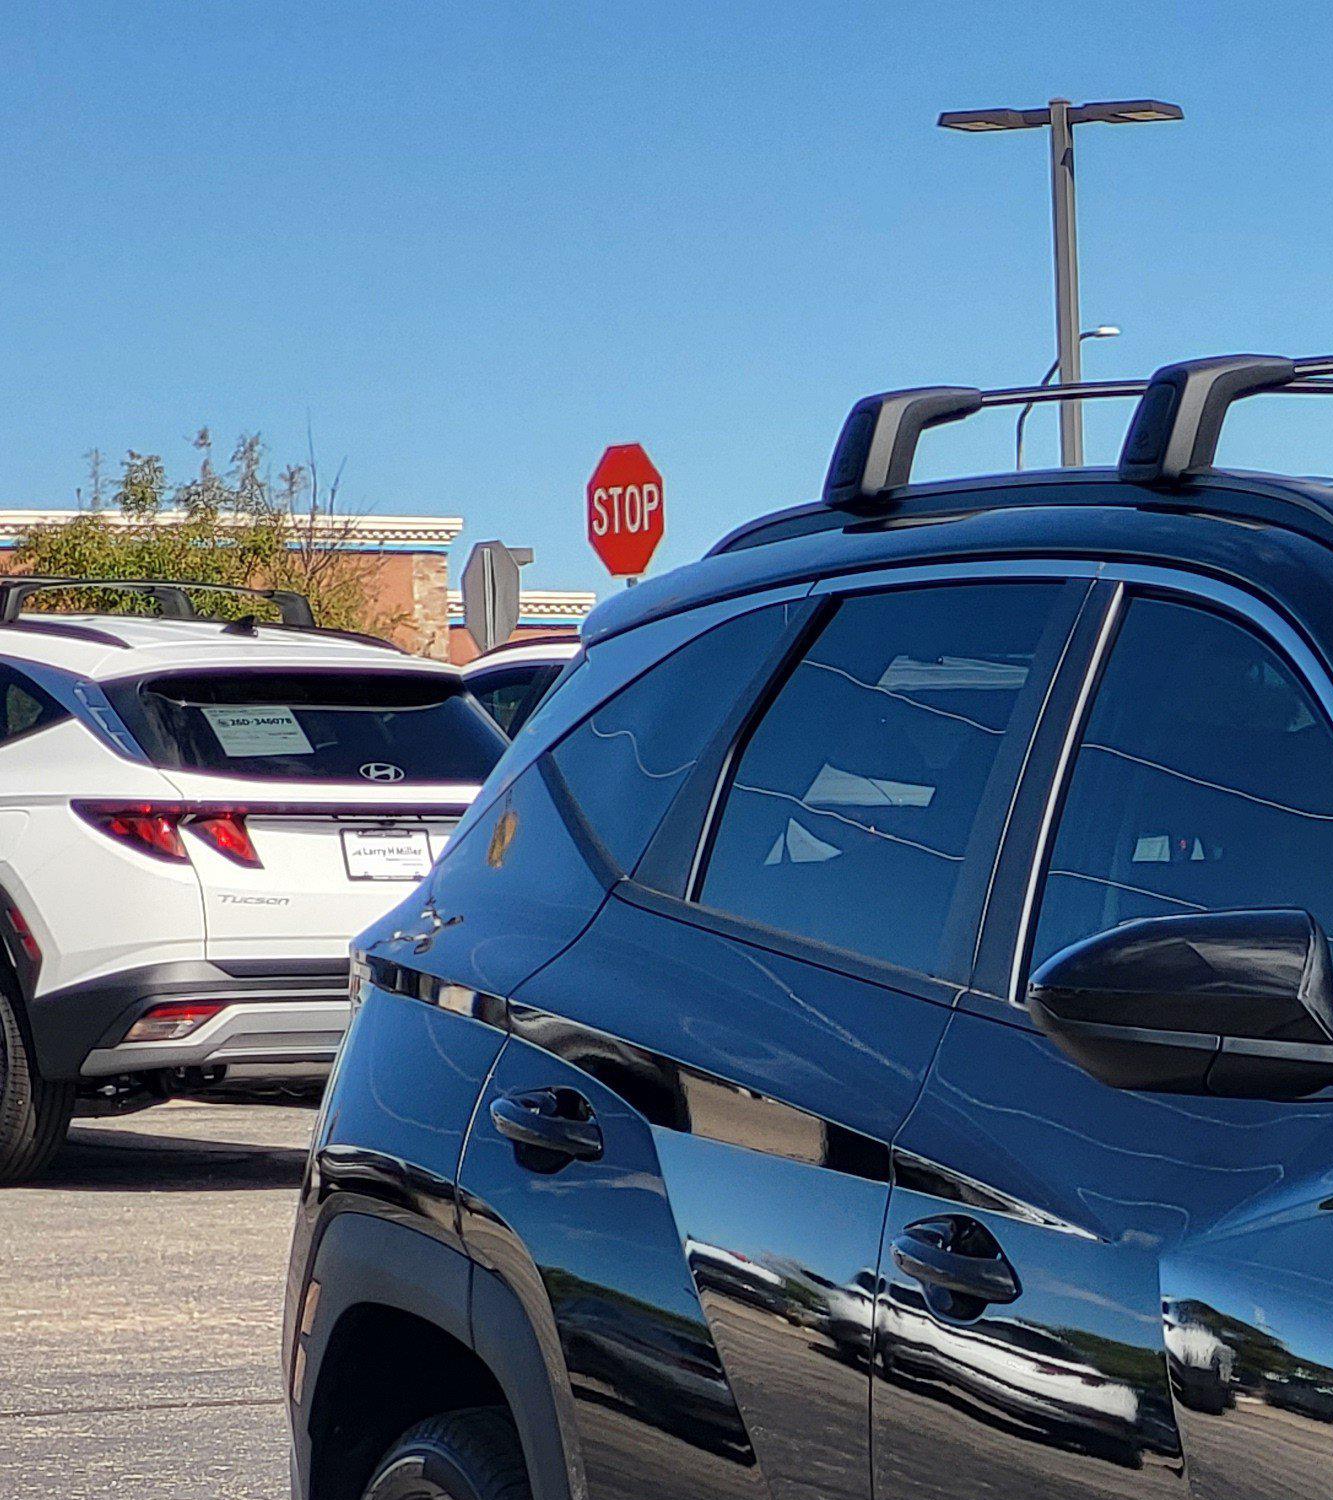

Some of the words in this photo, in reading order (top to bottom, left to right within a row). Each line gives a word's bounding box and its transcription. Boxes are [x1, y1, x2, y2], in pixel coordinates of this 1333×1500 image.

[592, 483, 659, 536] STOP
[363, 847, 386, 857] Larry
[396, 846, 422, 856] Miller
[217, 894, 290, 906] Tucson
